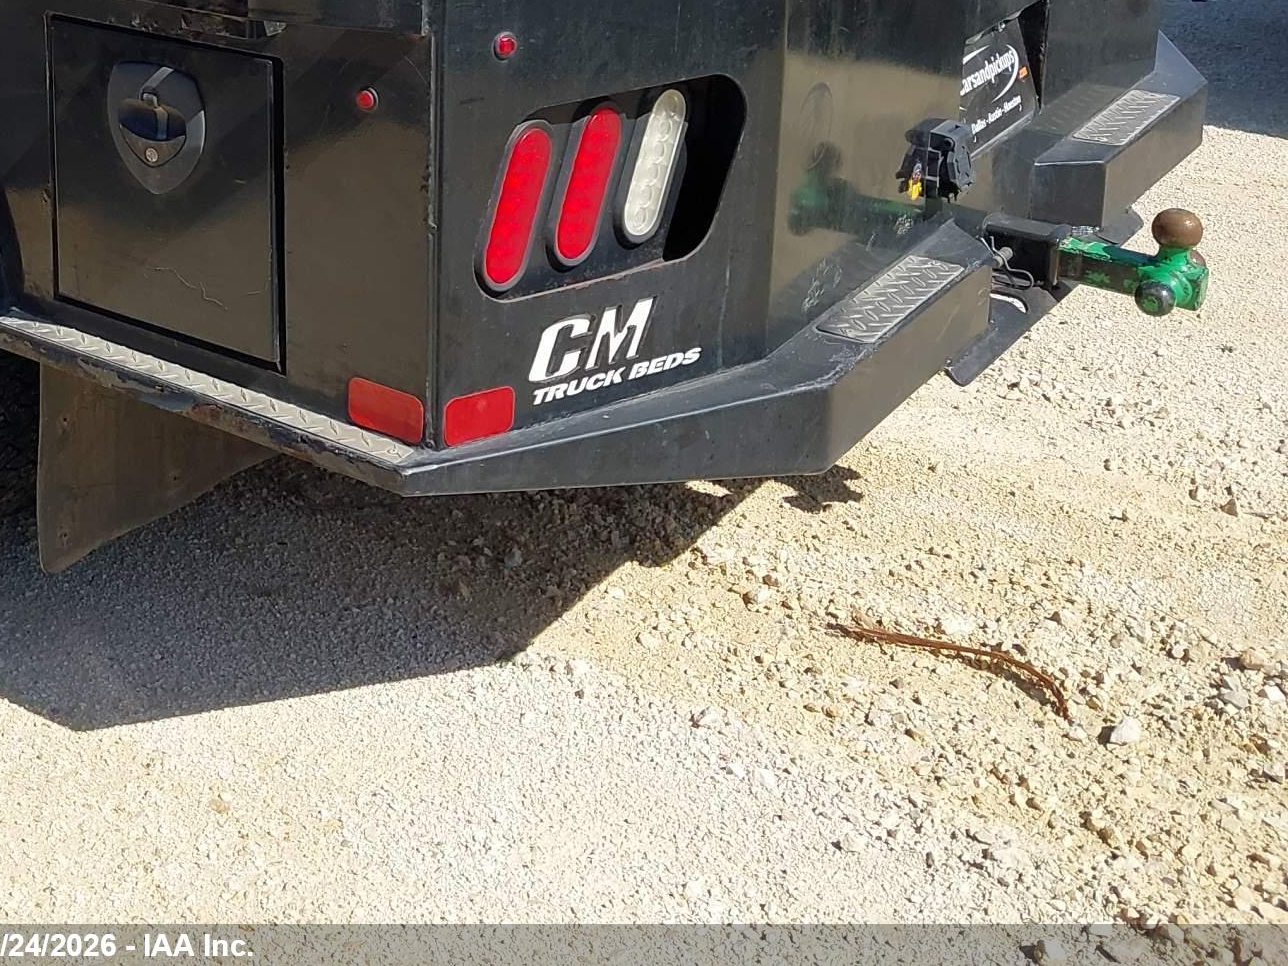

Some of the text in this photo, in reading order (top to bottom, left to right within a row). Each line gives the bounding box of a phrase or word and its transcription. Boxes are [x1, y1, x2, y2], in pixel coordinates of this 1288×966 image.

[528, 296, 655, 382] CM
[533, 347, 703, 405] TRUCK BEDS
